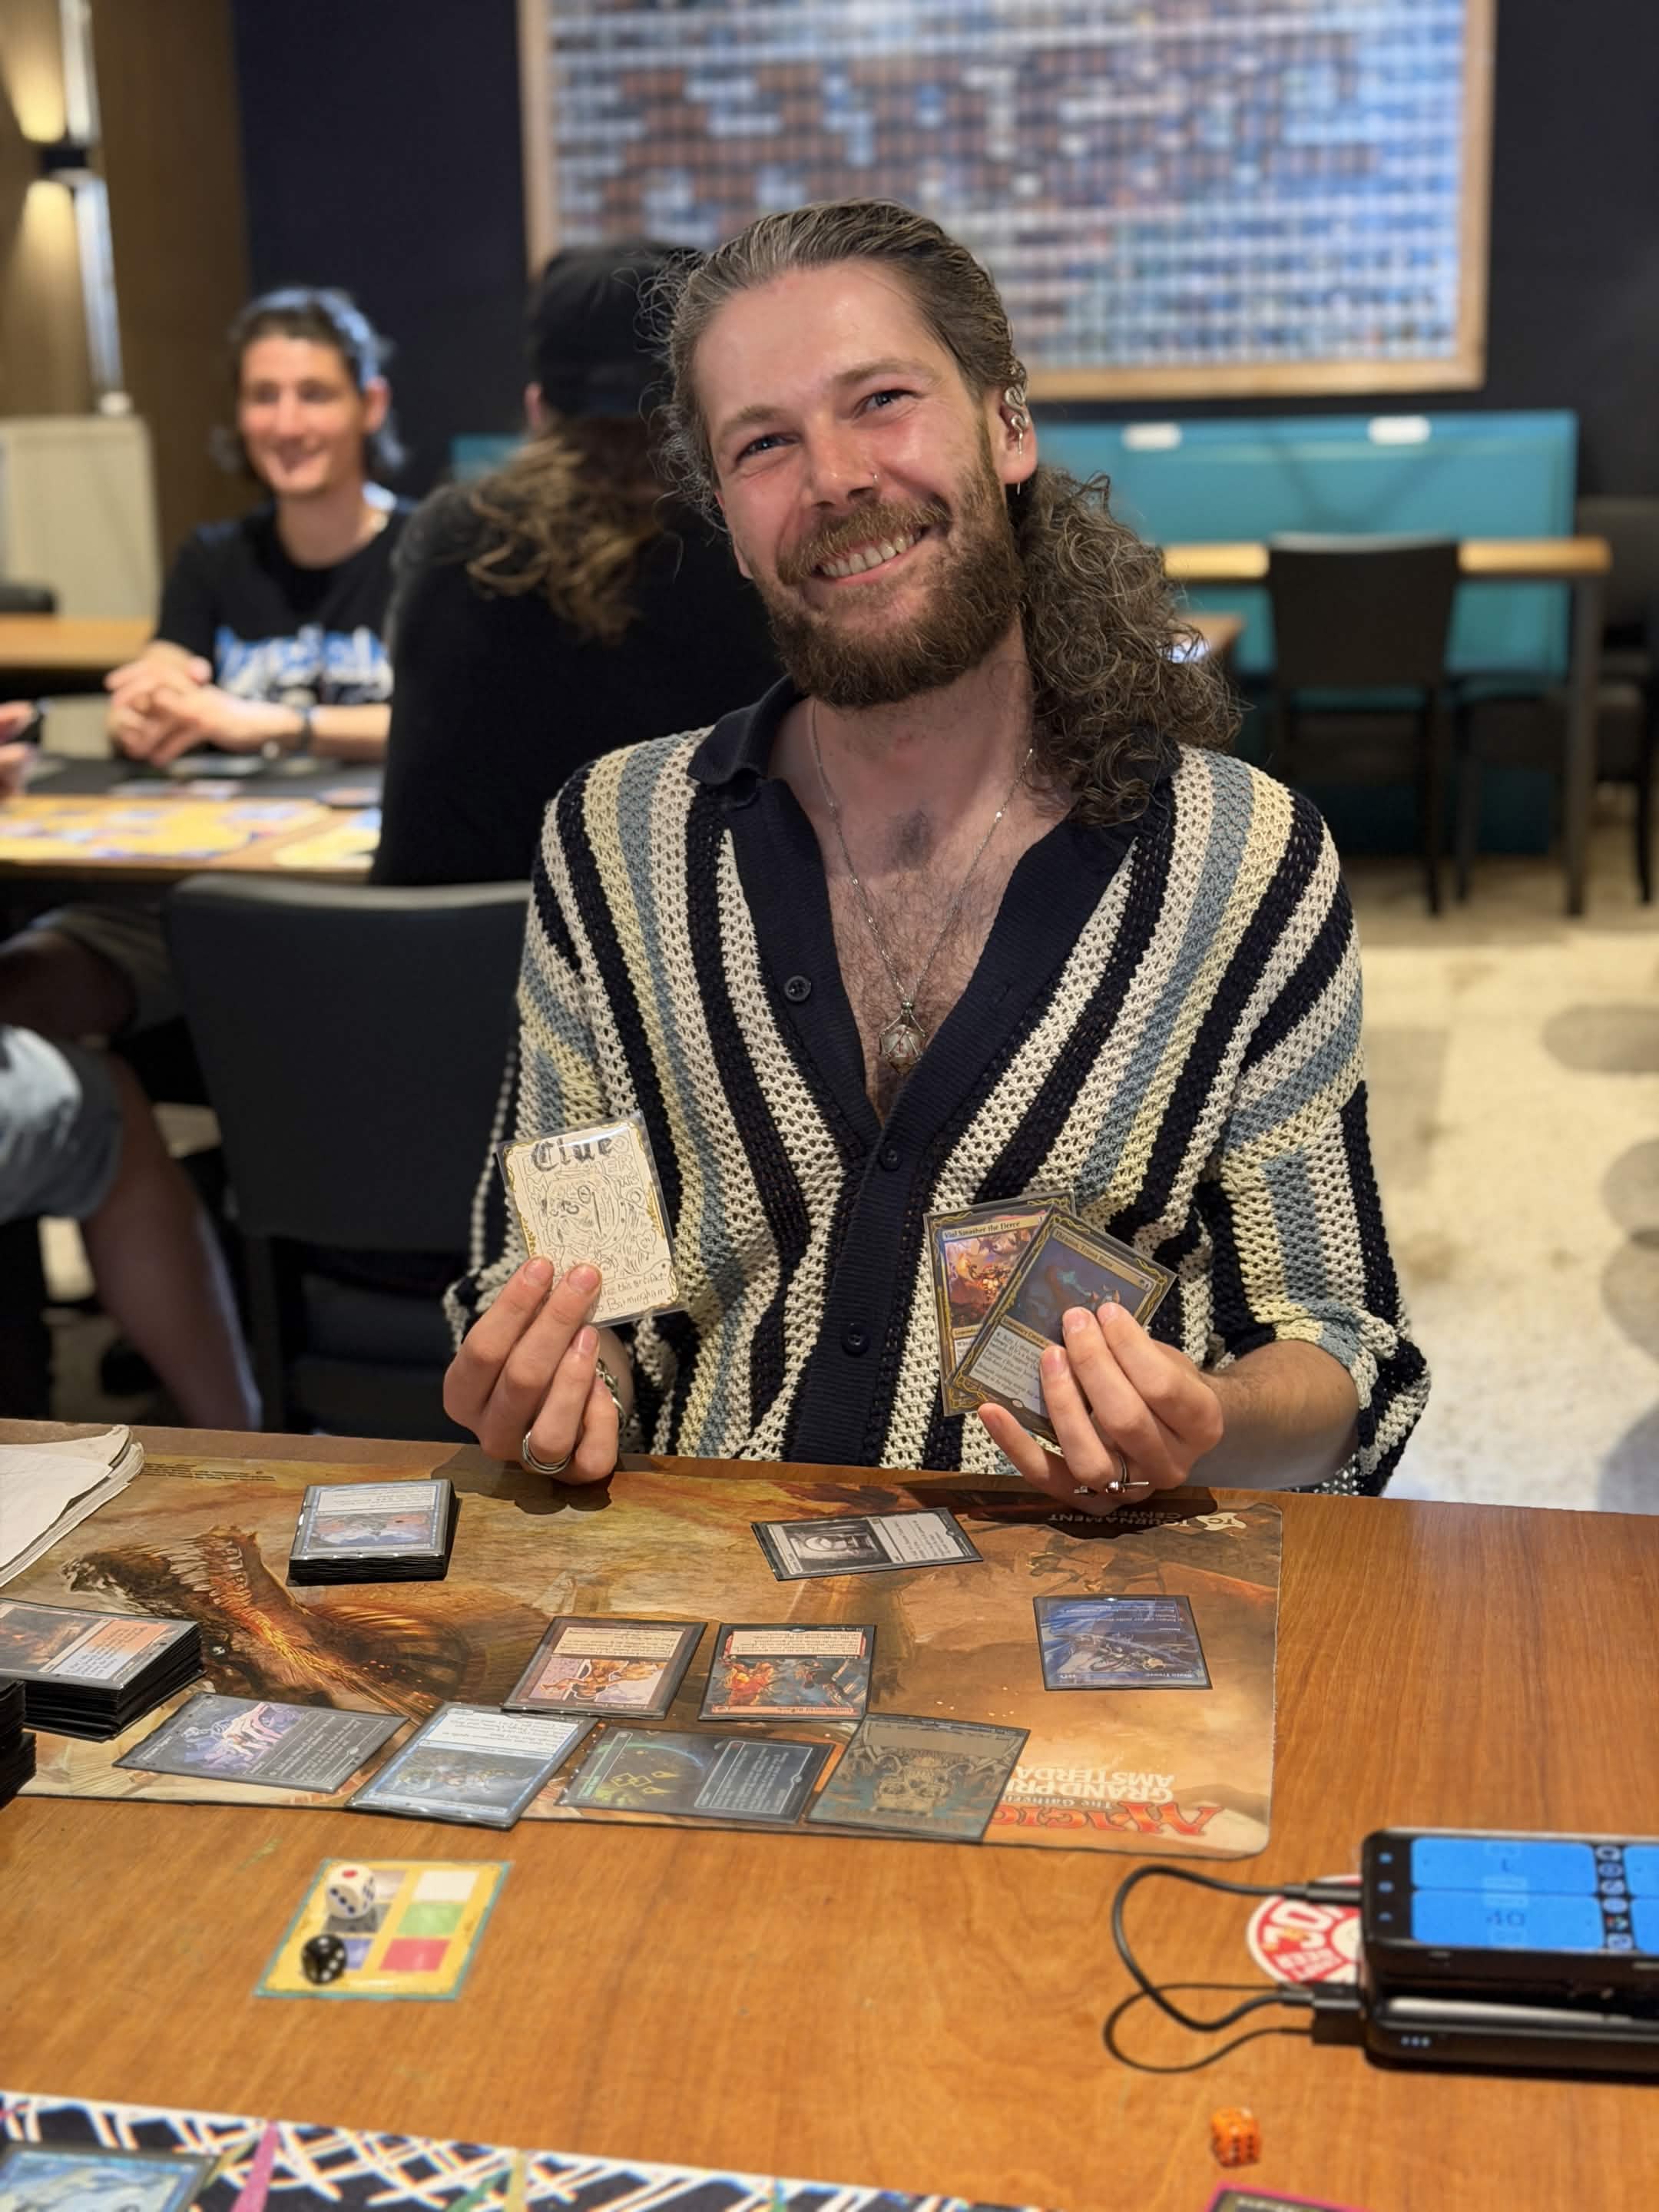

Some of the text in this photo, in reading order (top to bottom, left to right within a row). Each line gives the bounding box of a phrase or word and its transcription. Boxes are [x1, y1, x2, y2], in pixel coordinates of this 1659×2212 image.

[530, 1137, 613, 1172] Clue
[988, 1224, 998, 1232] the
[1000, 1220, 1021, 1230] Fierce
[1048, 1513, 1236, 1527] TOURNAMENT TC
[1015, 1766, 1174, 1789] AMSTERDA
[1005, 1777, 1174, 1804] GRAND PRI
[1081, 1799, 1113, 1810] The
[990, 1801, 1225, 1836] MAGIC
